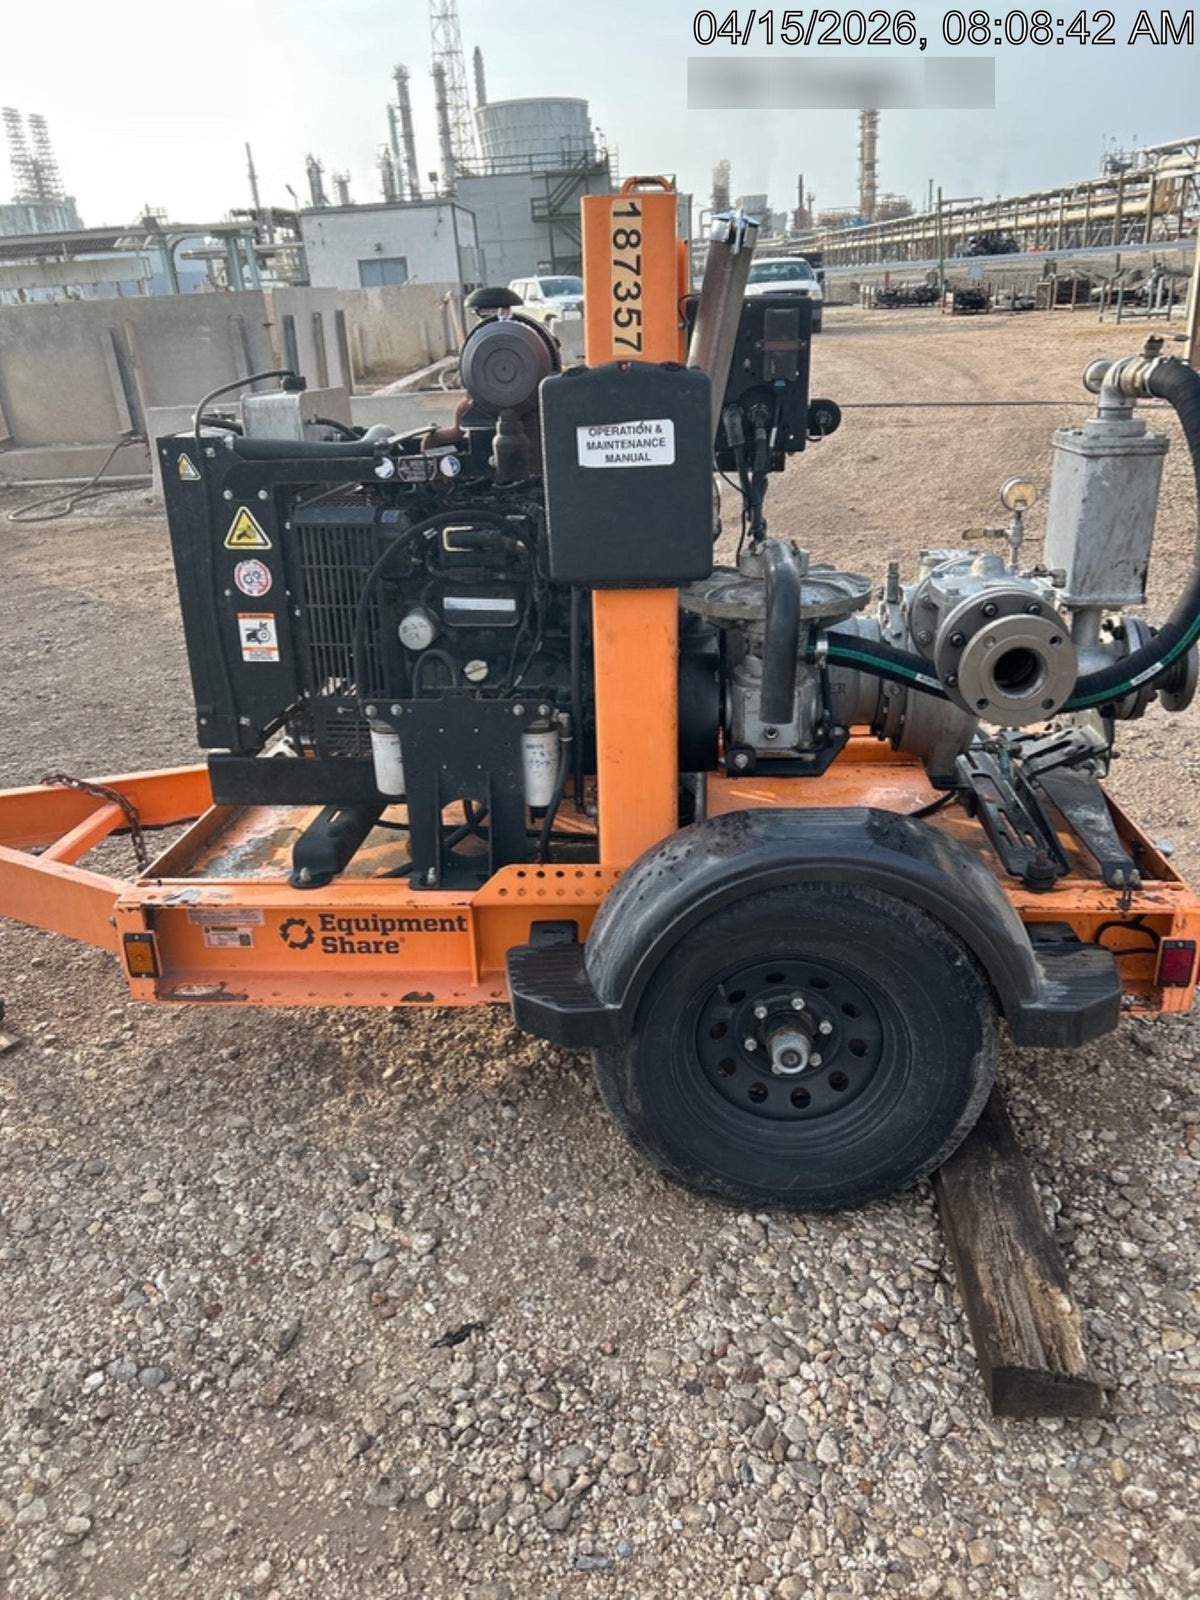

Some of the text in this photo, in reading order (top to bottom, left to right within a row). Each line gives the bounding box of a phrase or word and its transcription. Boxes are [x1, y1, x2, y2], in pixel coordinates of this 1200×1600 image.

[612, 202, 642, 353] 187357
[588, 424, 662, 437] OPERATION &
[586, 437, 666, 450] MAINTENANCE
[605, 453, 651, 463] MANUAL
[319, 913, 467, 936] Equipment
